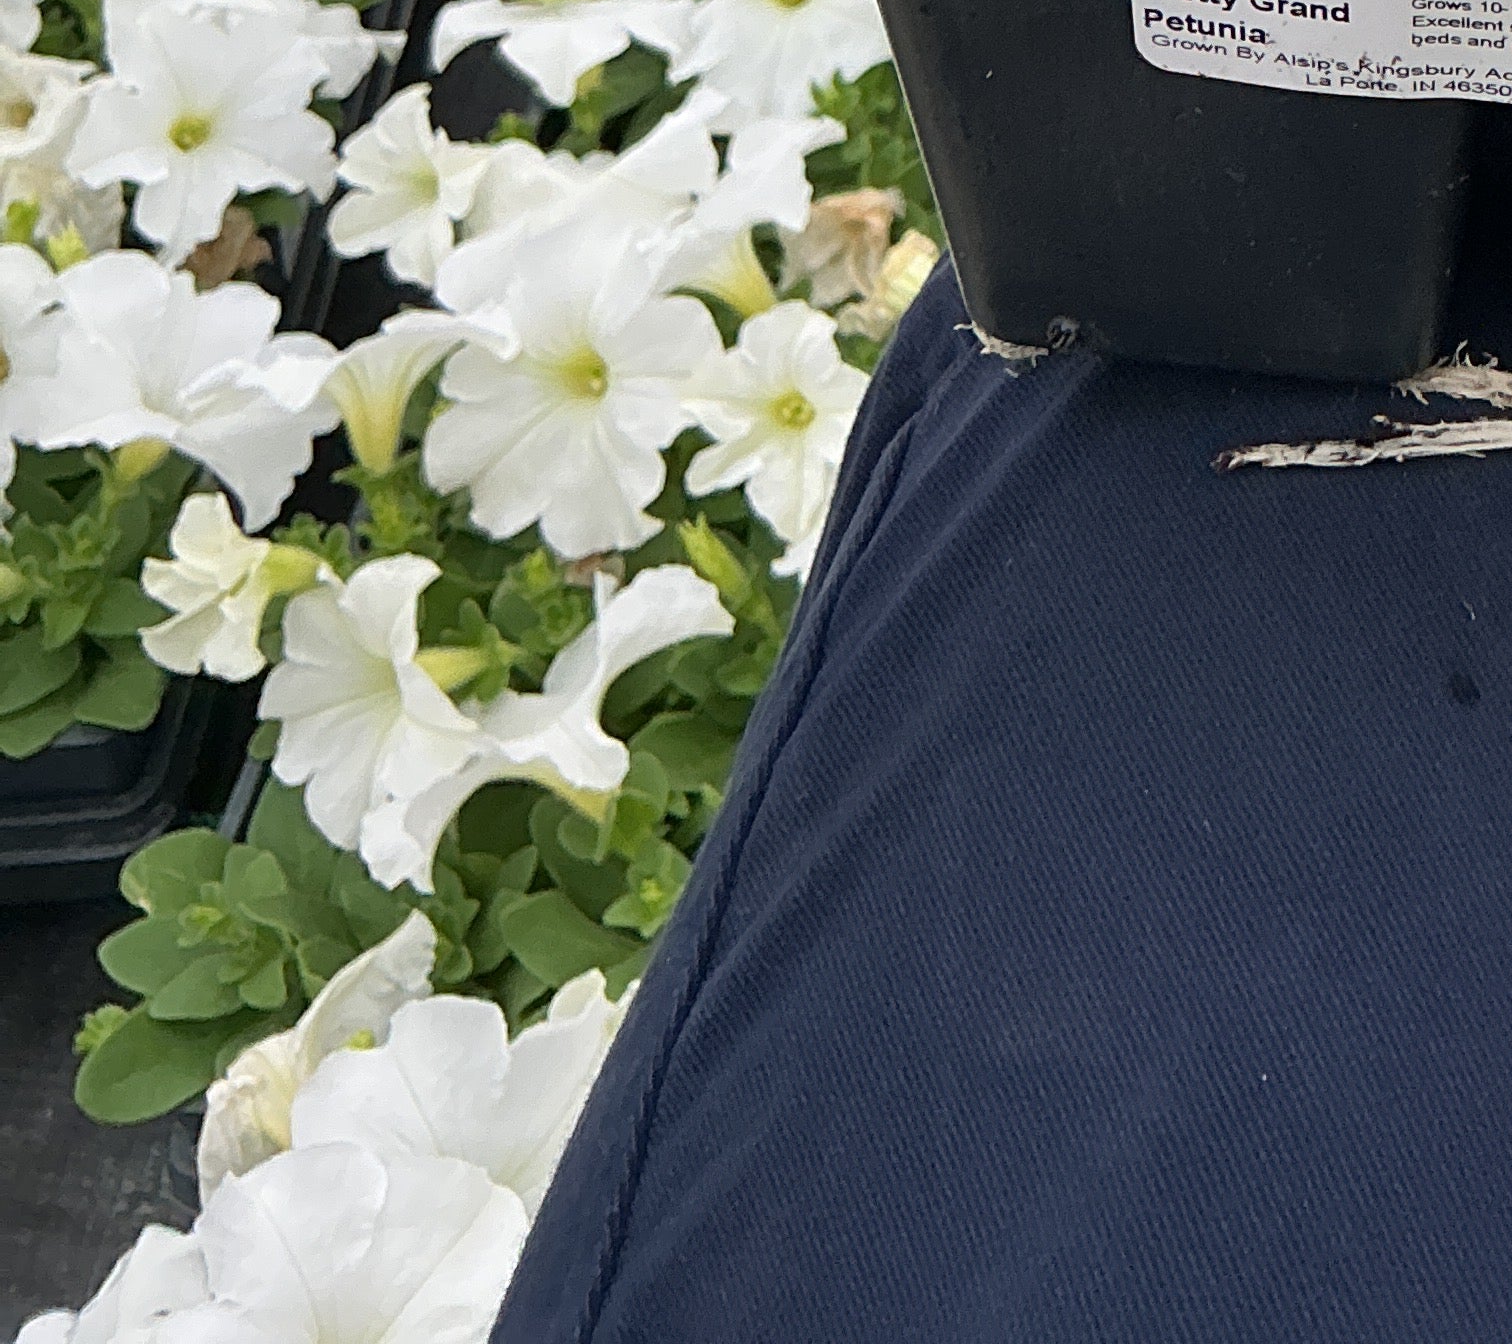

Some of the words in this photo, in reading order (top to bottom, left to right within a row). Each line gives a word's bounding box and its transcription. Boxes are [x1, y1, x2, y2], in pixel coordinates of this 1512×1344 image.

[1144, 8, 1268, 44] Petunia
[1412, 15, 1503, 32] Excellent
[1411, 33, 1462, 46] beds
[1468, 36, 1506, 49] and
[1151, 33, 1228, 56] Grown
[1236, 46, 1265, 64] By
[1274, 52, 1349, 74] Alsip's
[1359, 58, 1476, 79] Kingsbury
[1305, 73, 1332, 88] La
[1412, 79, 1436, 92] IN
[1442, 80, 1512, 97] 46350
